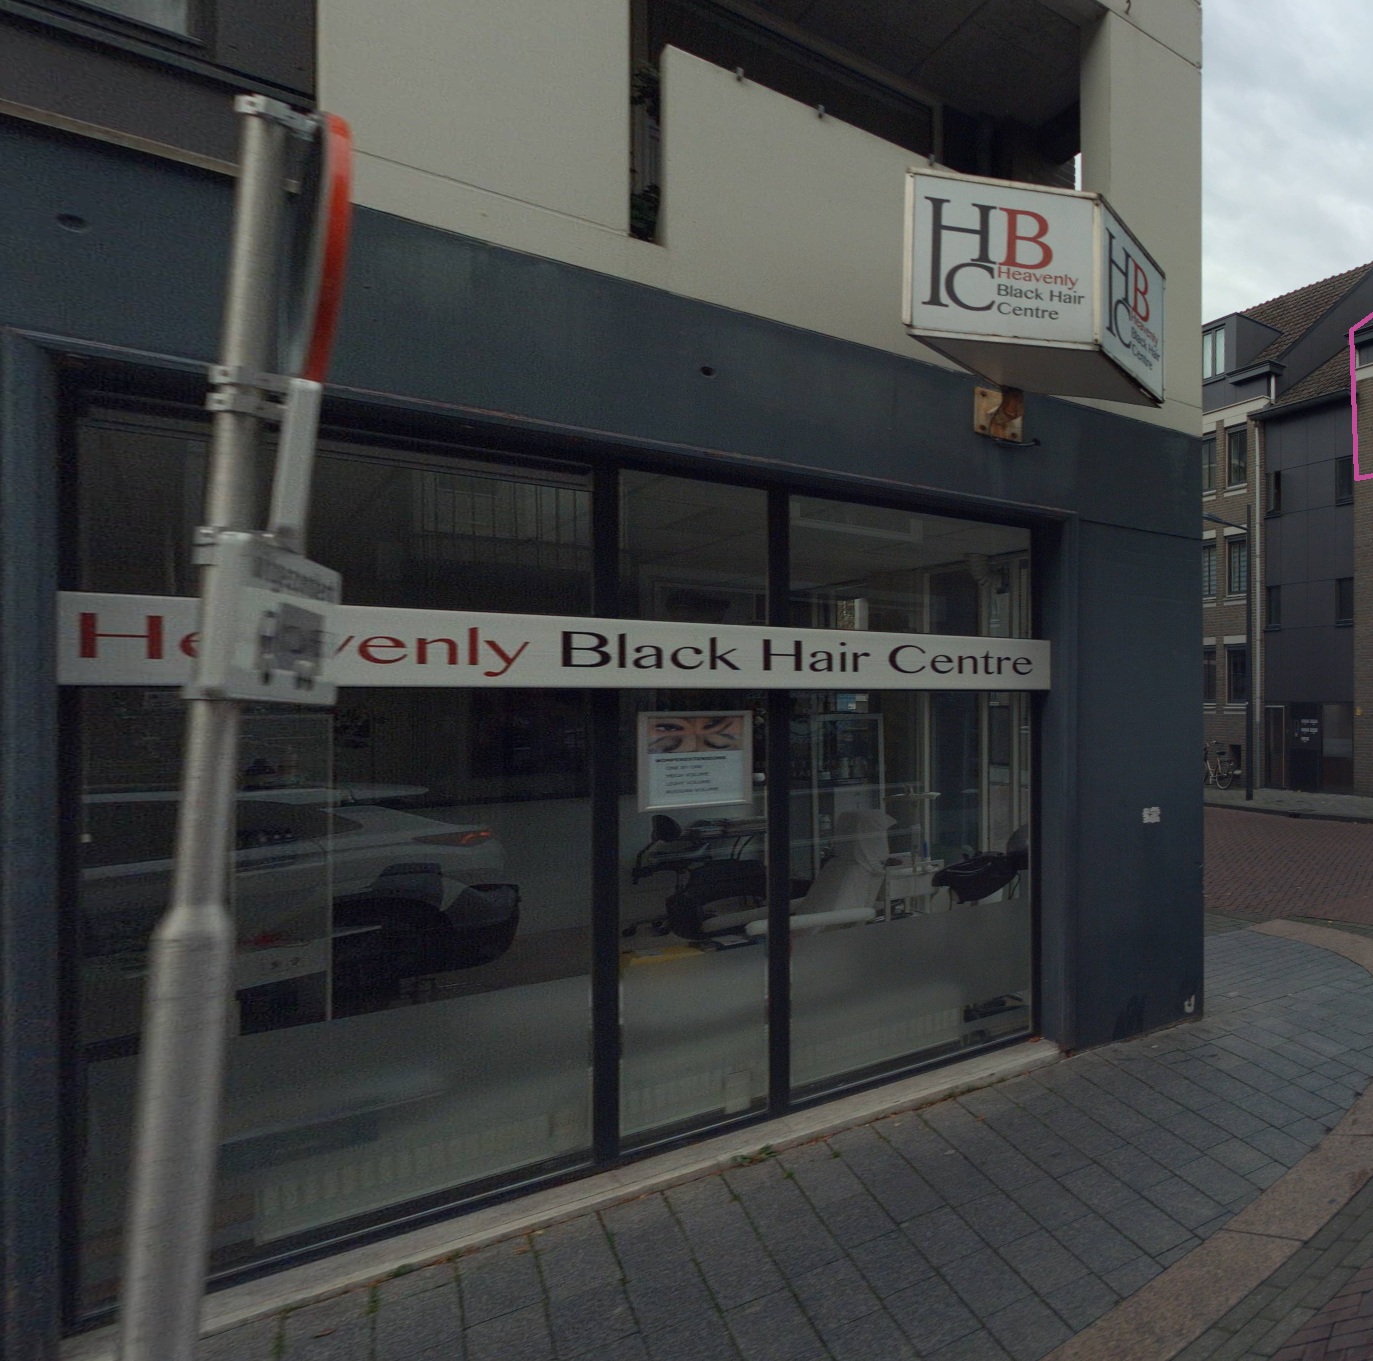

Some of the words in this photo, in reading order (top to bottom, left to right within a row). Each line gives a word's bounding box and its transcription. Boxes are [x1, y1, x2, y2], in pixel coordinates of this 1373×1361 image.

[997, 265, 1079, 290] Heavenly
[997, 283, 1044, 302] Black
[1049, 291, 1086, 306] Hair
[997, 302, 1060, 321] Centre
[560, 630, 742, 672] Black
[761, 637, 871, 675] Hair
[888, 643, 1035, 676] Centre
